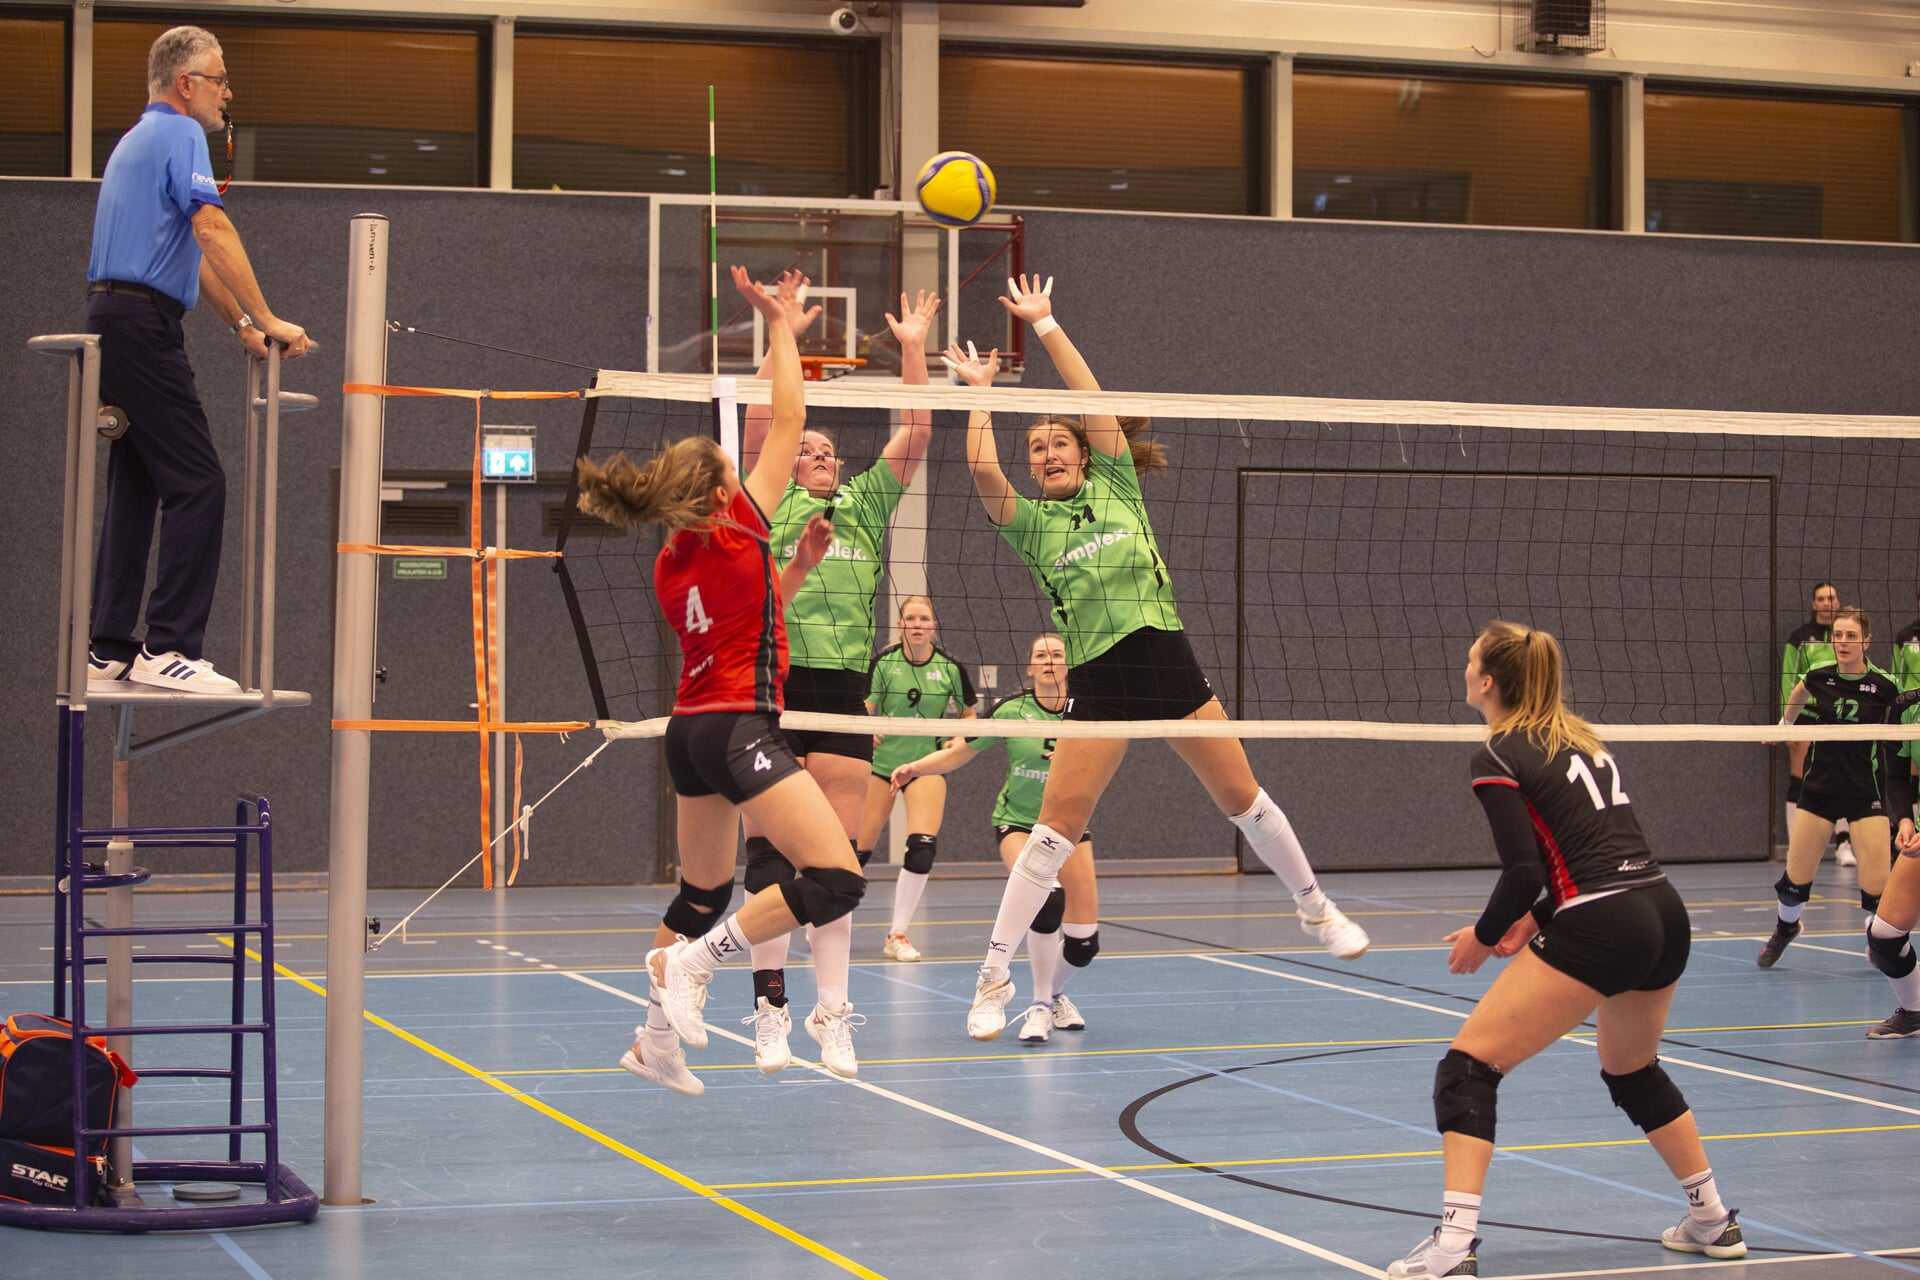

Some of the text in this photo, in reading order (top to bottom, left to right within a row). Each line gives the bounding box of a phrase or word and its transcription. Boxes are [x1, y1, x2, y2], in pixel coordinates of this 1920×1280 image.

[686, 585, 714, 634] 4
[907, 688, 922, 709] 9
[1834, 697, 1860, 722] 12
[754, 750, 772, 772] 4
[1566, 750, 1630, 811] 12
[11, 1163, 69, 1187] STAR
